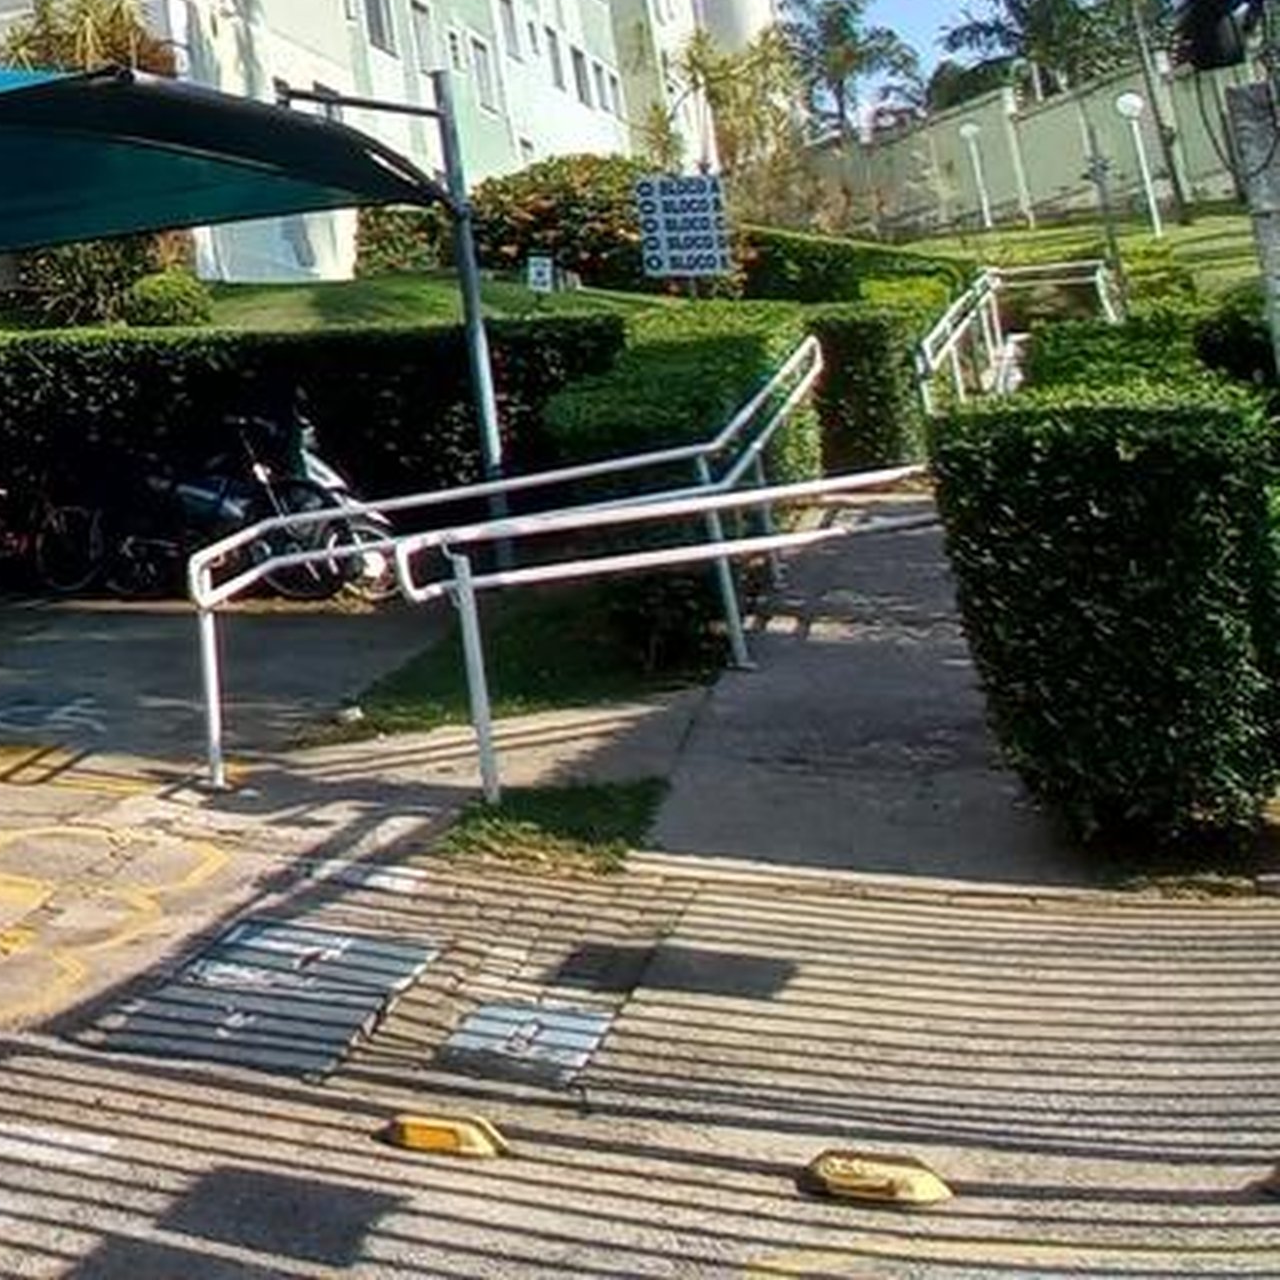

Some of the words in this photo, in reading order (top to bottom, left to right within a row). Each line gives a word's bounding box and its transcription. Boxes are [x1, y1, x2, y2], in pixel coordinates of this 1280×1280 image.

[659, 179, 707, 195] BLOCO
[711, 179, 721, 193] A
[662, 198, 709, 214] BLOCO
[665, 216, 710, 231] BLOCO
[715, 216, 727, 230] C
[667, 235, 714, 250] BLOCO
[670, 253, 717, 270] BLOCO
